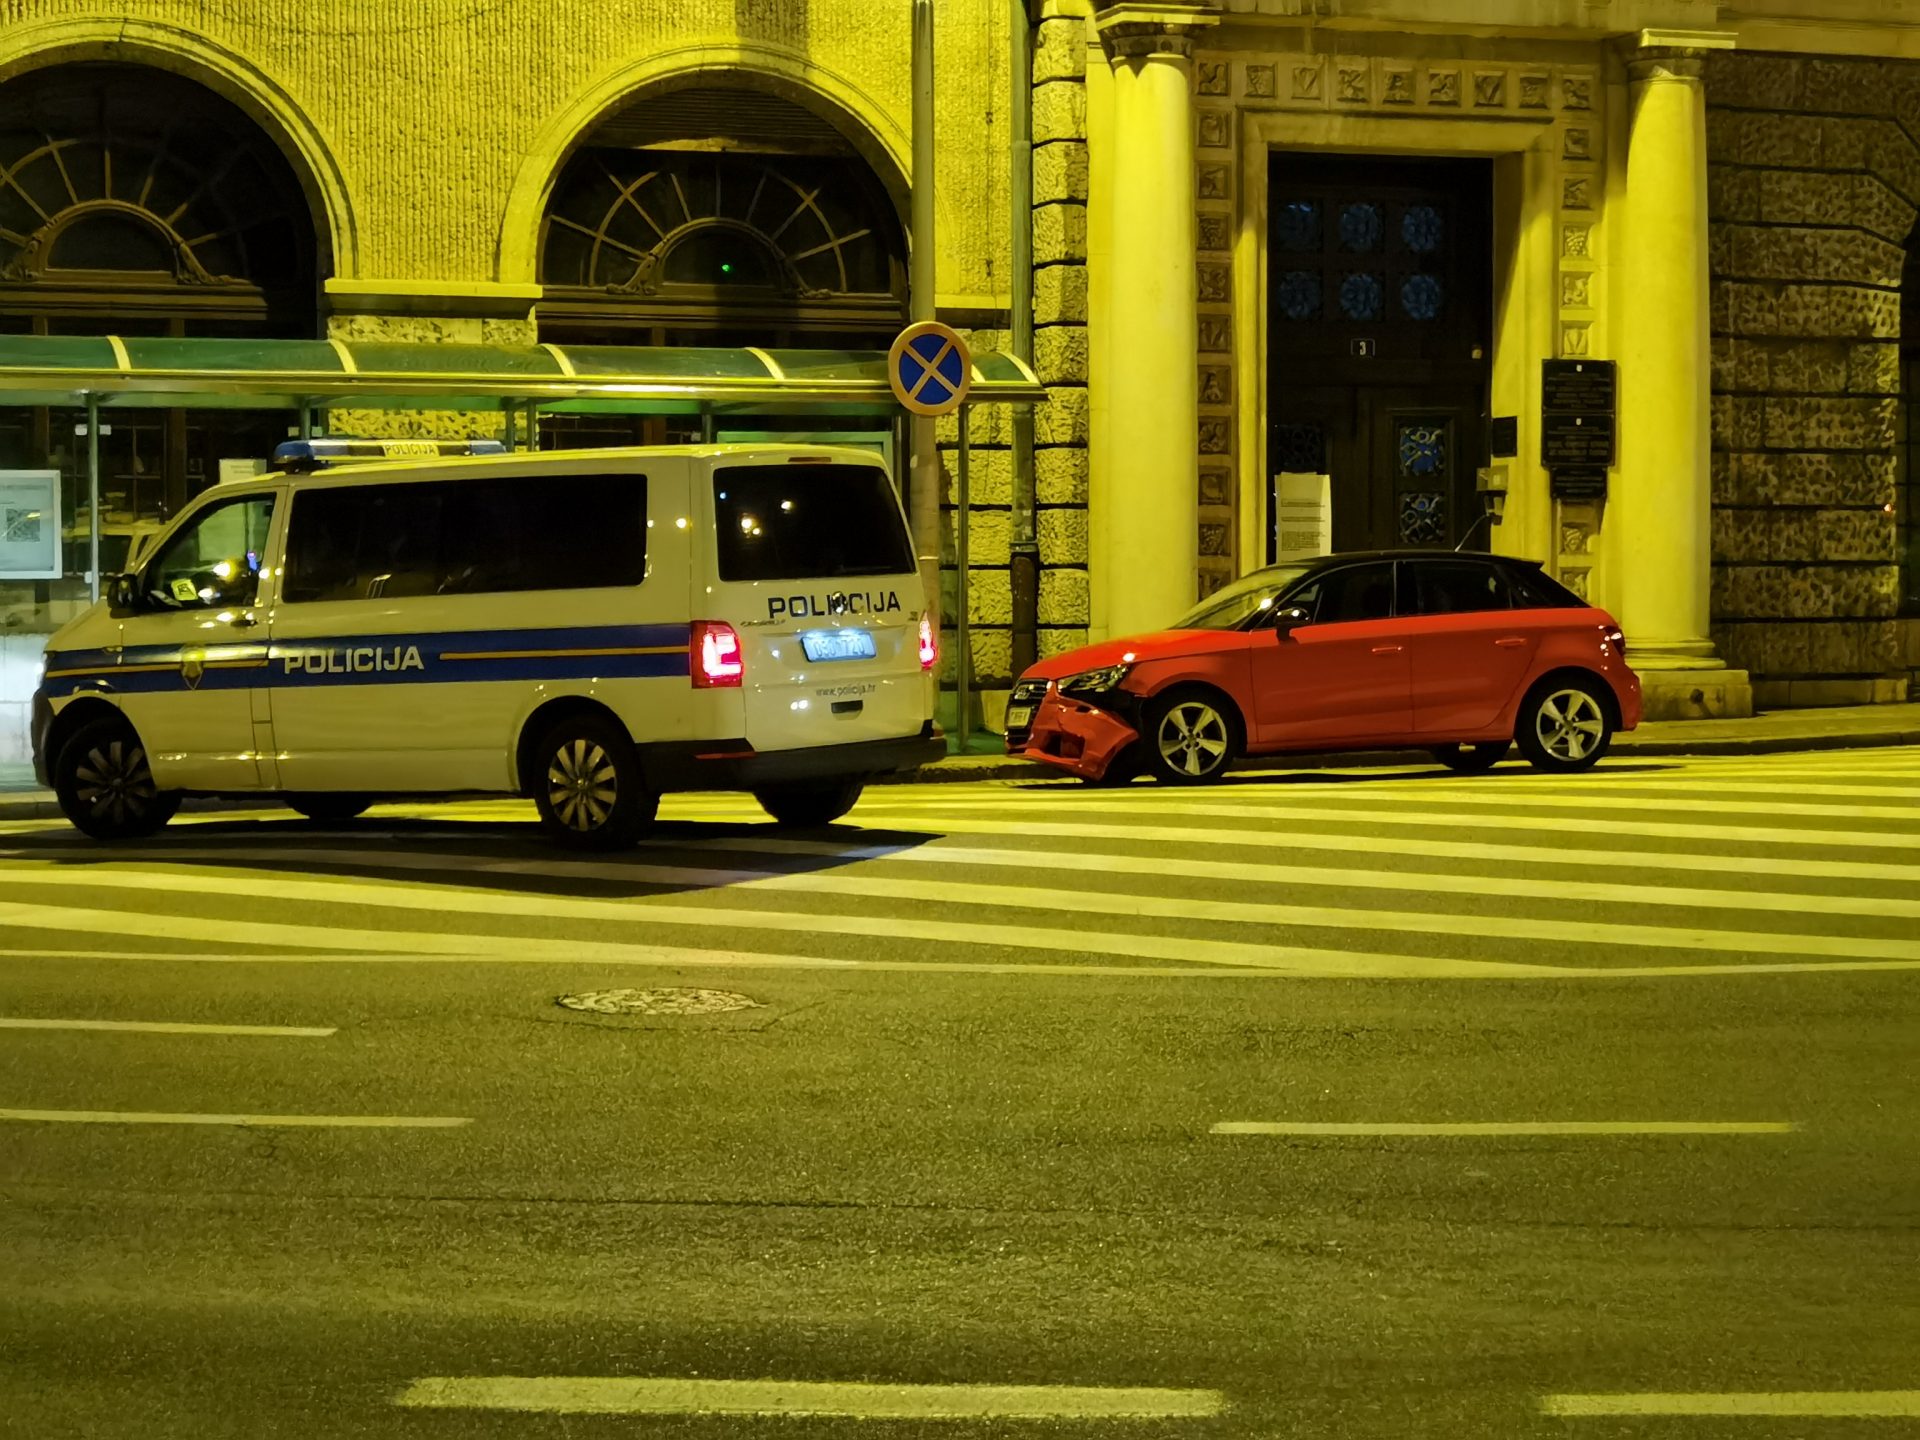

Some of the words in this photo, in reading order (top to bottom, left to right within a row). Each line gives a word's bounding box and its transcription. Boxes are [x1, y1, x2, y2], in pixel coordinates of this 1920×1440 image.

[1359, 341, 1367, 356] 3
[384, 443, 436, 457] POLICIJA
[768, 591, 901, 619] POLICIJA
[284, 645, 425, 674] POLICIJA
